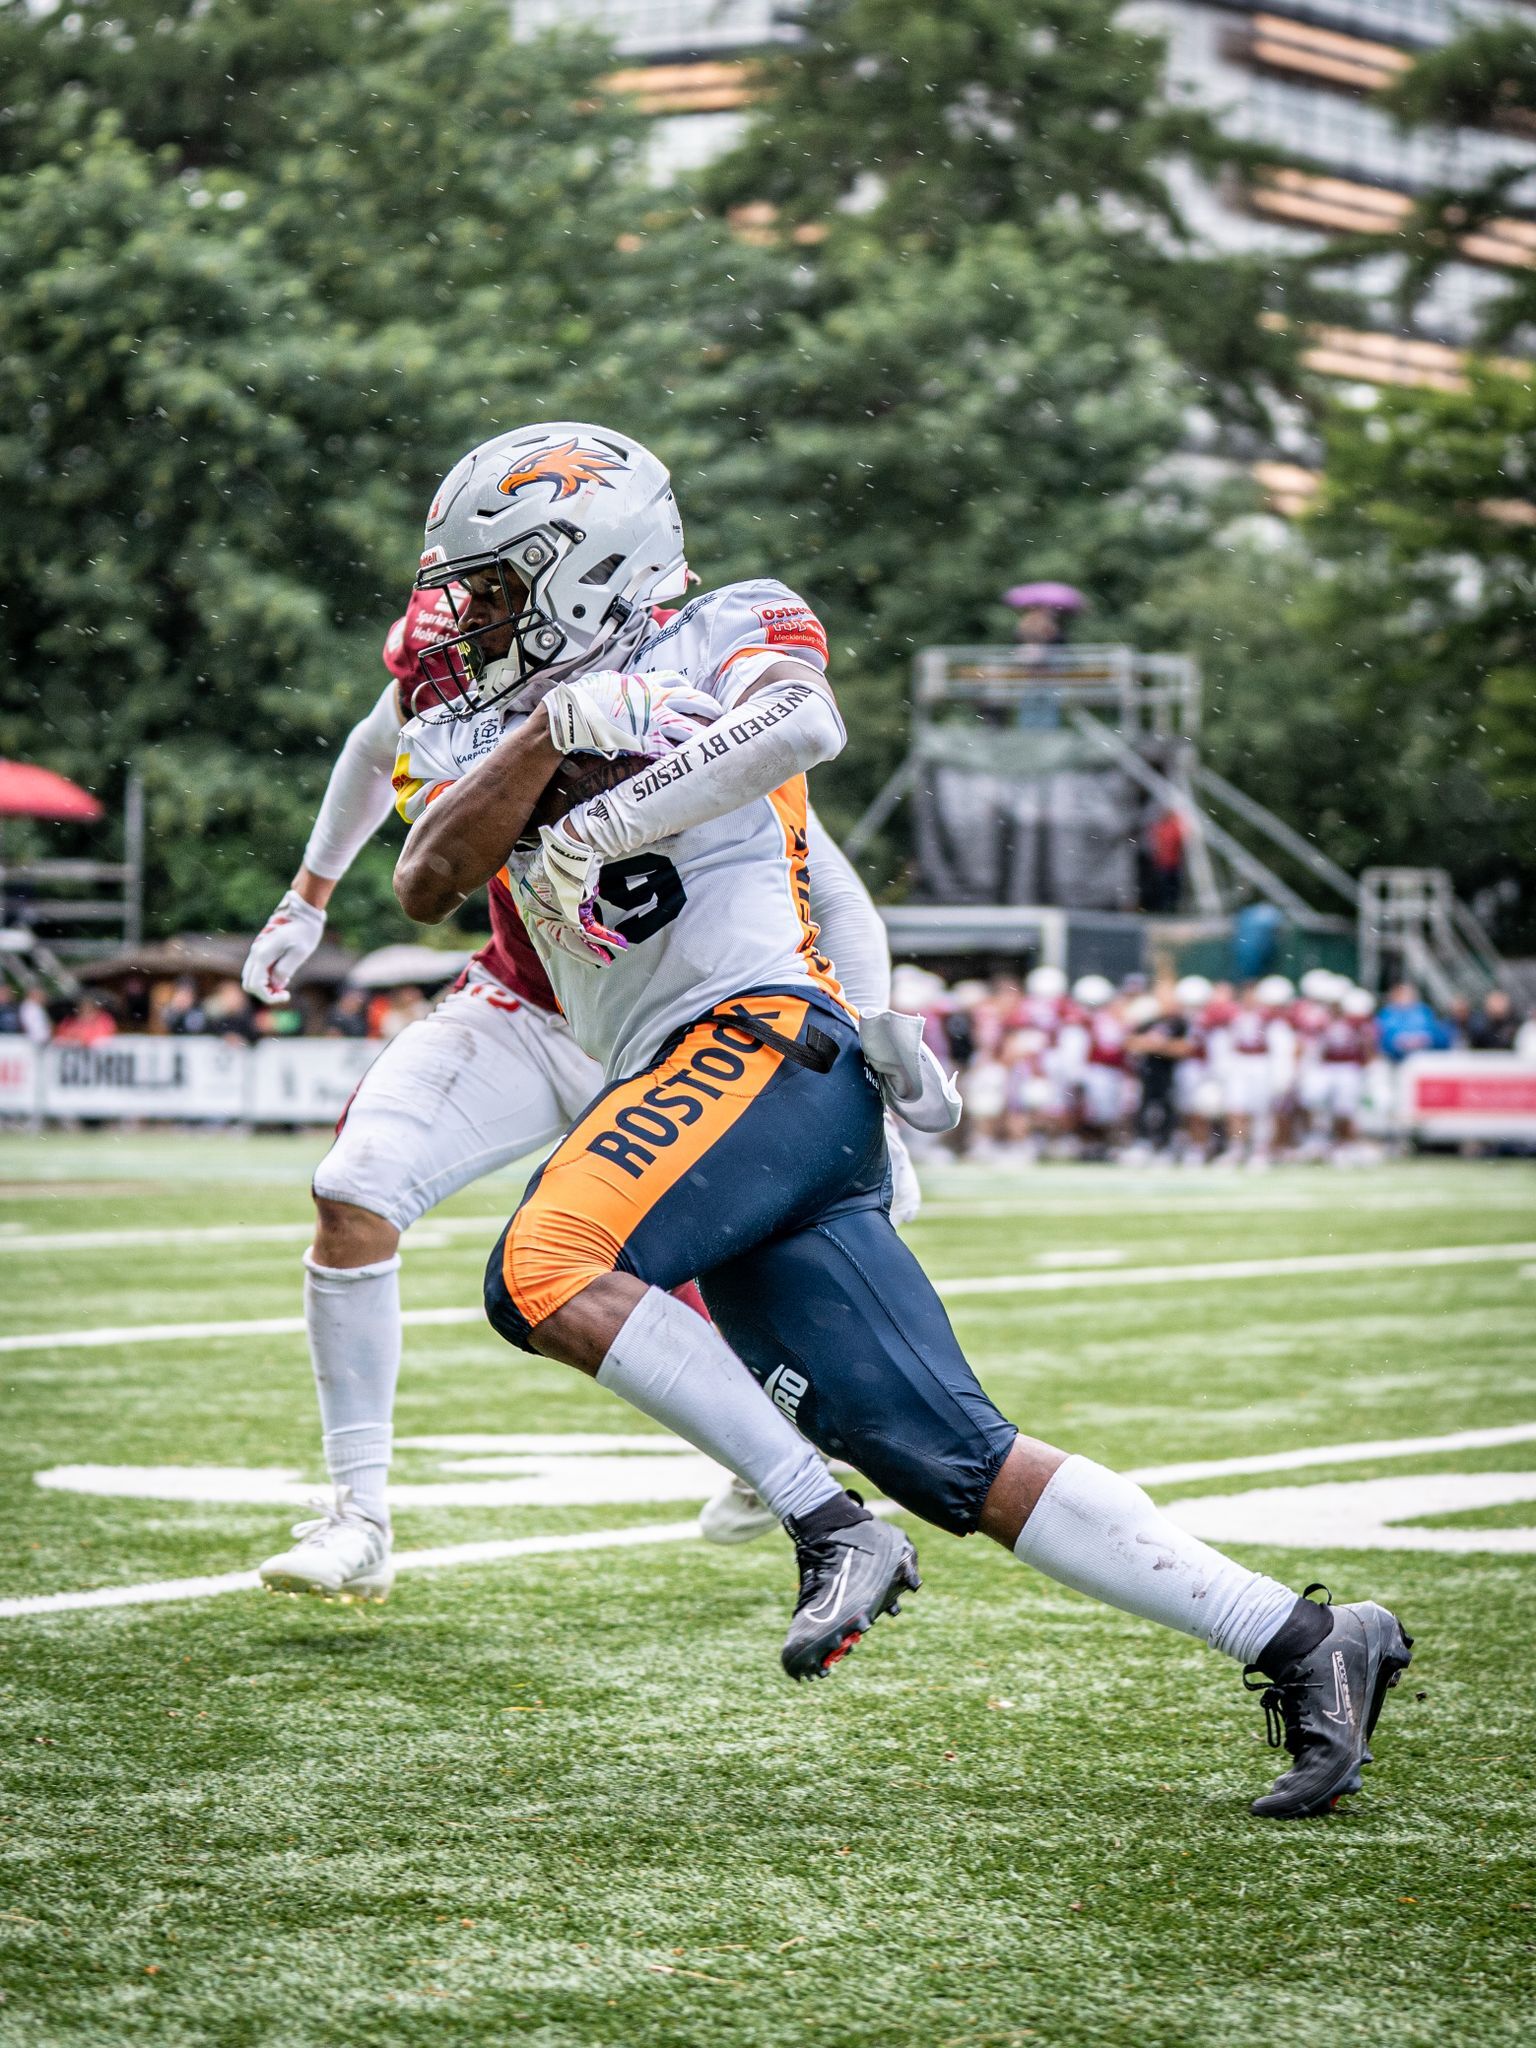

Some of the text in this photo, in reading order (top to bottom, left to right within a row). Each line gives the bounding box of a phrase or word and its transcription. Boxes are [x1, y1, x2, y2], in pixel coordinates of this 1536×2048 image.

[411, 626, 454, 644] Holstei
[697, 732, 730, 765] BY
[632, 750, 693, 802] JESUS
[591, 852, 688, 959] 9
[585, 1004, 781, 1179] ROSTOCK
